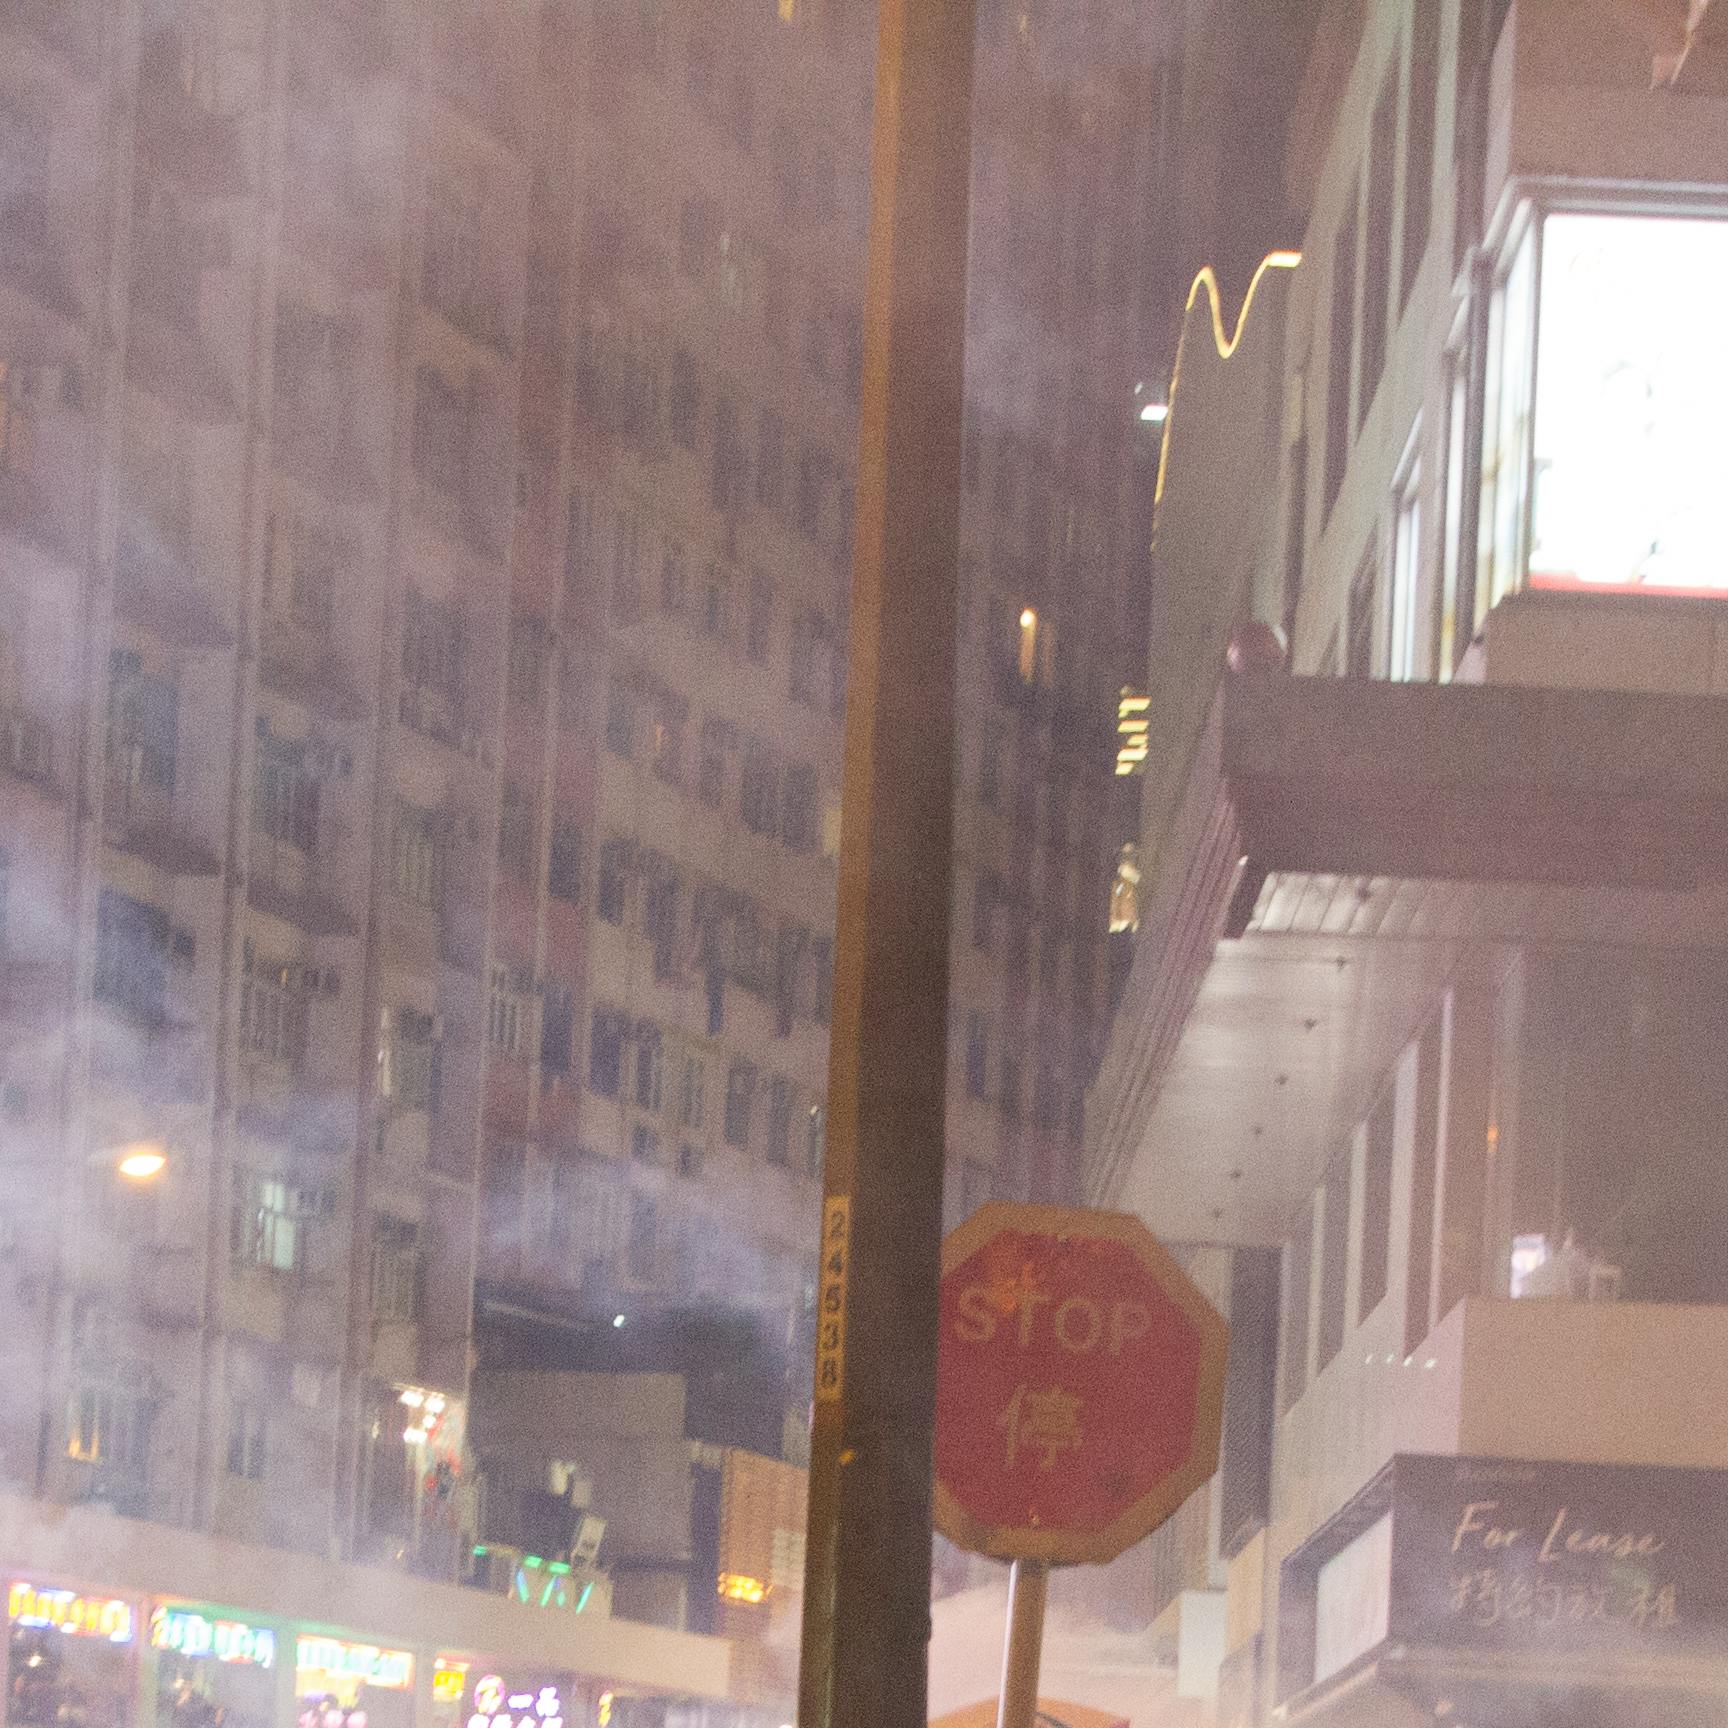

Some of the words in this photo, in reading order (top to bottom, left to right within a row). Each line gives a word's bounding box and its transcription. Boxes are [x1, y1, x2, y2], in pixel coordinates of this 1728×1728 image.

[954, 1288, 1153, 1356] STOP
[997, 1384, 1085, 1470] 停
[1451, 1500, 1520, 1552] For
[1537, 1506, 1665, 1563] Lease
